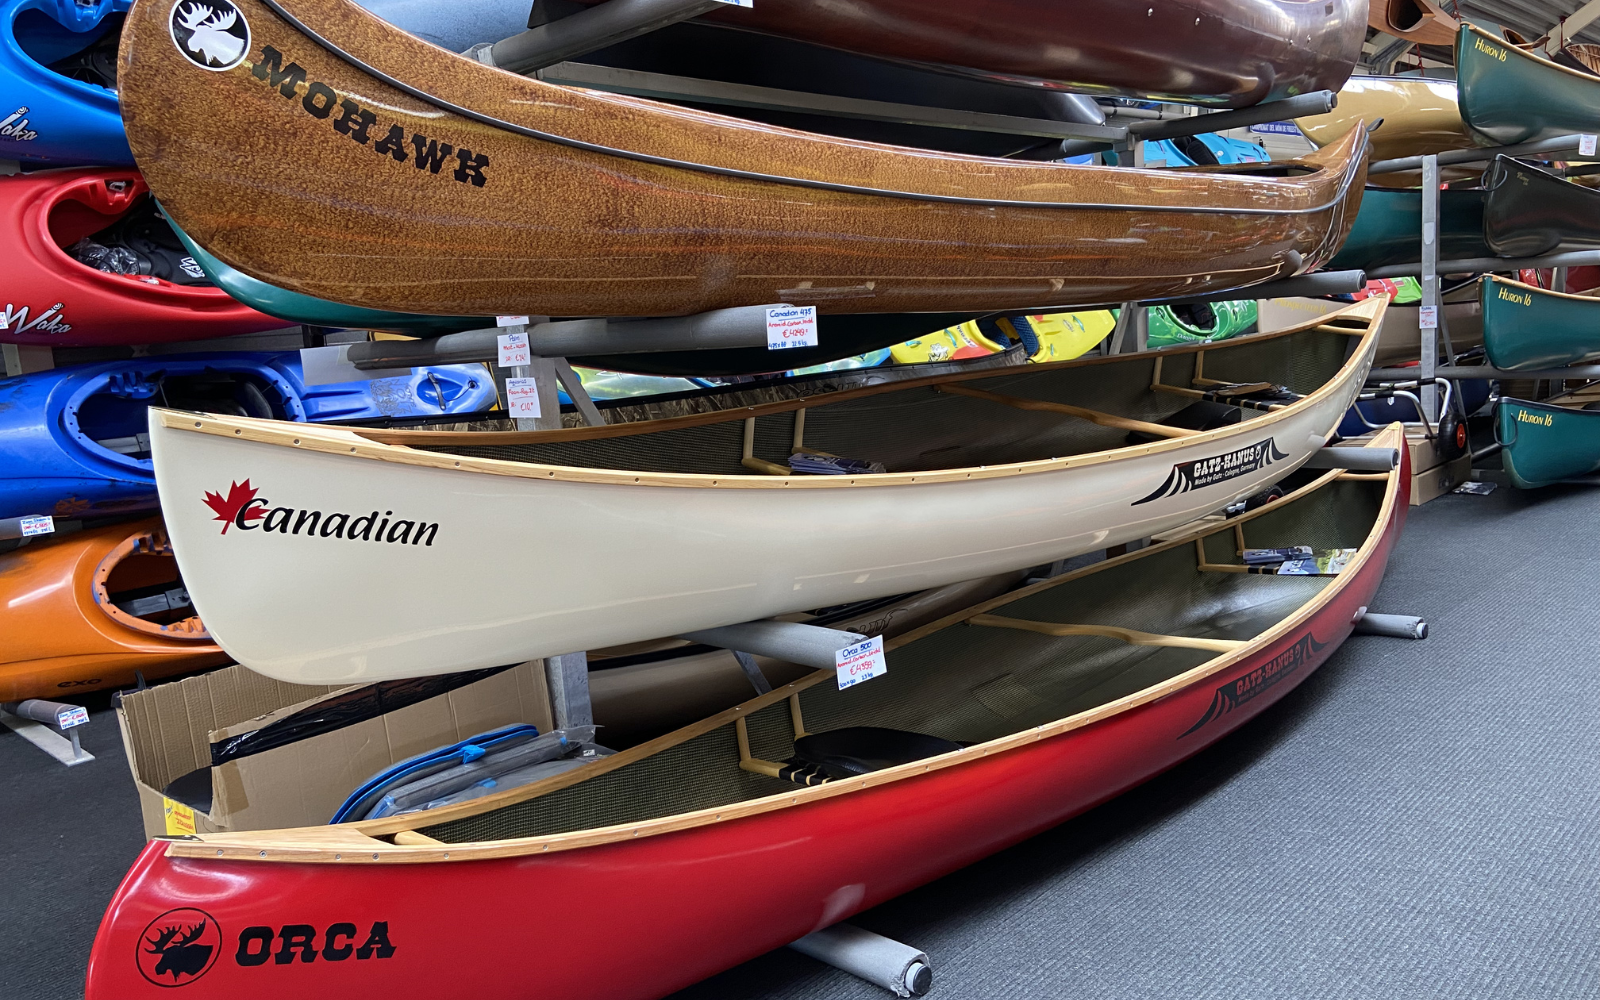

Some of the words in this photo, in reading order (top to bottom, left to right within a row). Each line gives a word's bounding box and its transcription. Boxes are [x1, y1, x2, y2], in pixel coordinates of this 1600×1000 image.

[1498, 48, 1508, 62] 16
[251, 44, 491, 188] MOHAWK
[1523, 293, 1532, 307] 16
[799, 307, 812, 317] 475
[1544, 413, 1553, 427] 16
[1193, 446, 1255, 478] GATZ-KANUS
[235, 497, 440, 547] Canadian
[860, 641, 872, 651] 500
[1236, 648, 1294, 696] GATZ-KANUS
[235, 921, 398, 968] ORCA
